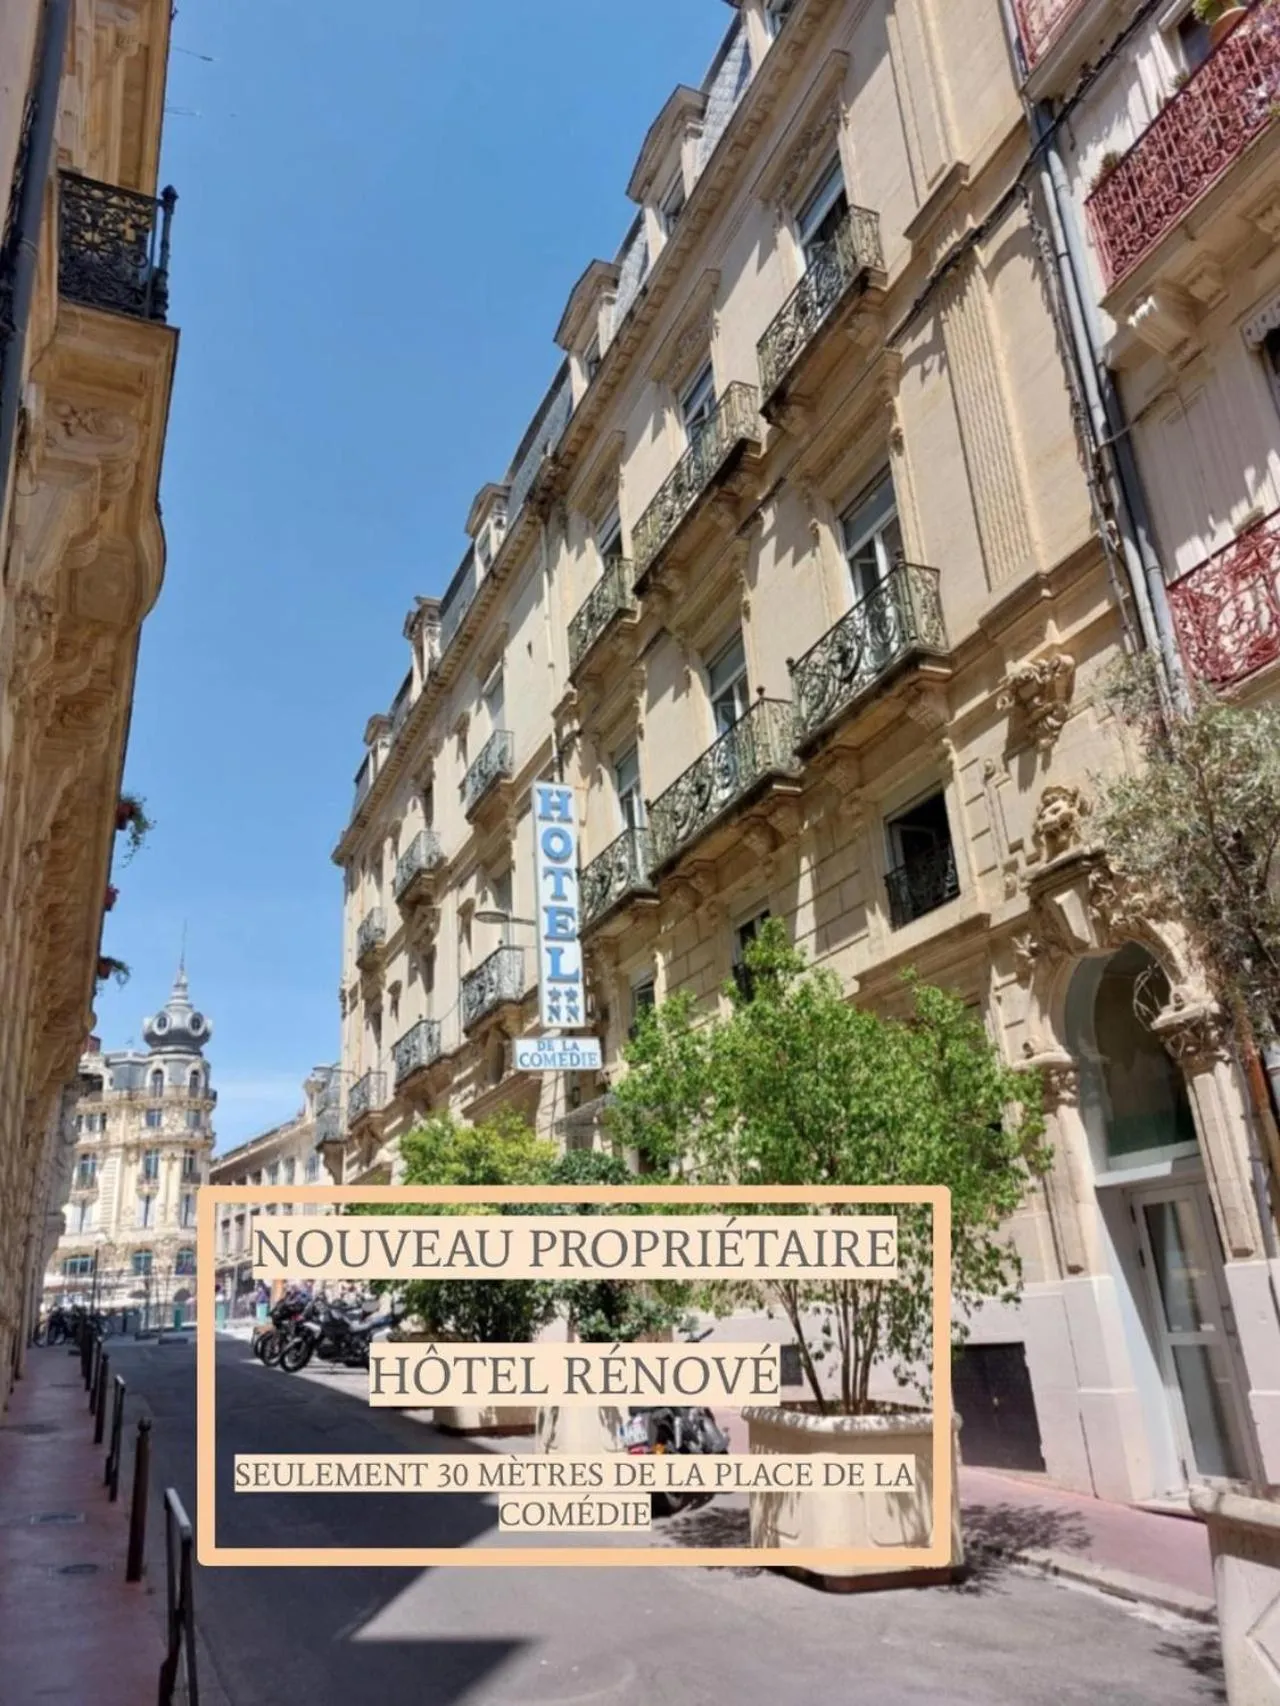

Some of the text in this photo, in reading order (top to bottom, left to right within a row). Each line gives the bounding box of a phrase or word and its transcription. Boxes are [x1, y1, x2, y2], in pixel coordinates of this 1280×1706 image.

[537, 788, 580, 984] HOTEL
[537, 1040, 580, 1051] DE LA
[519, 1052, 598, 1067] COMEDIE
